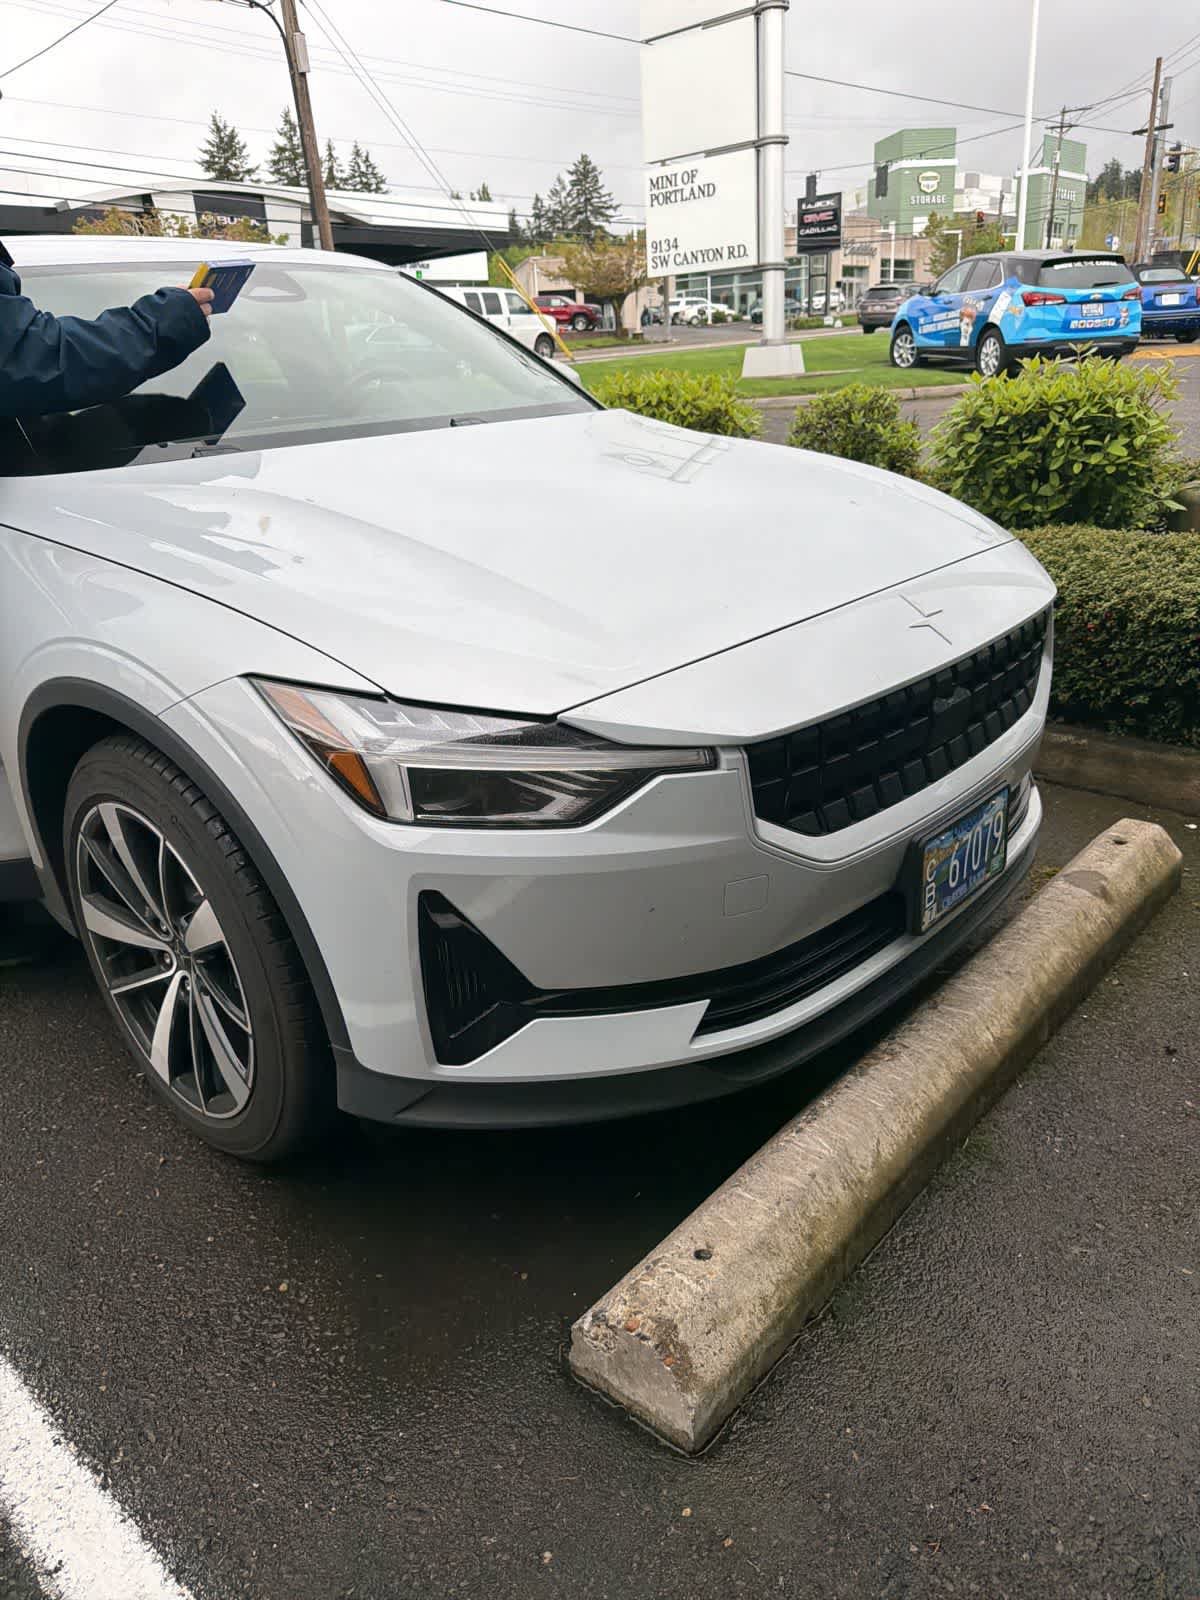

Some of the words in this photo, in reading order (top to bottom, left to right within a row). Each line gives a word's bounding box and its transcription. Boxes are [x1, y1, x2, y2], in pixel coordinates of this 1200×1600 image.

[649, 172, 678, 191] MINI
[681, 168, 698, 185] OF
[649, 182, 716, 207] PORTLAND
[911, 194, 946, 205] STORAGE
[803, 210, 834, 223] GMC
[800, 224, 838, 236] CADILLAC
[651, 237, 679, 254] 9134
[651, 254, 670, 270] SW
[673, 246, 724, 267] CANYON
[727, 244, 749, 260] RD.
[949, 811, 1003, 888] 67079
